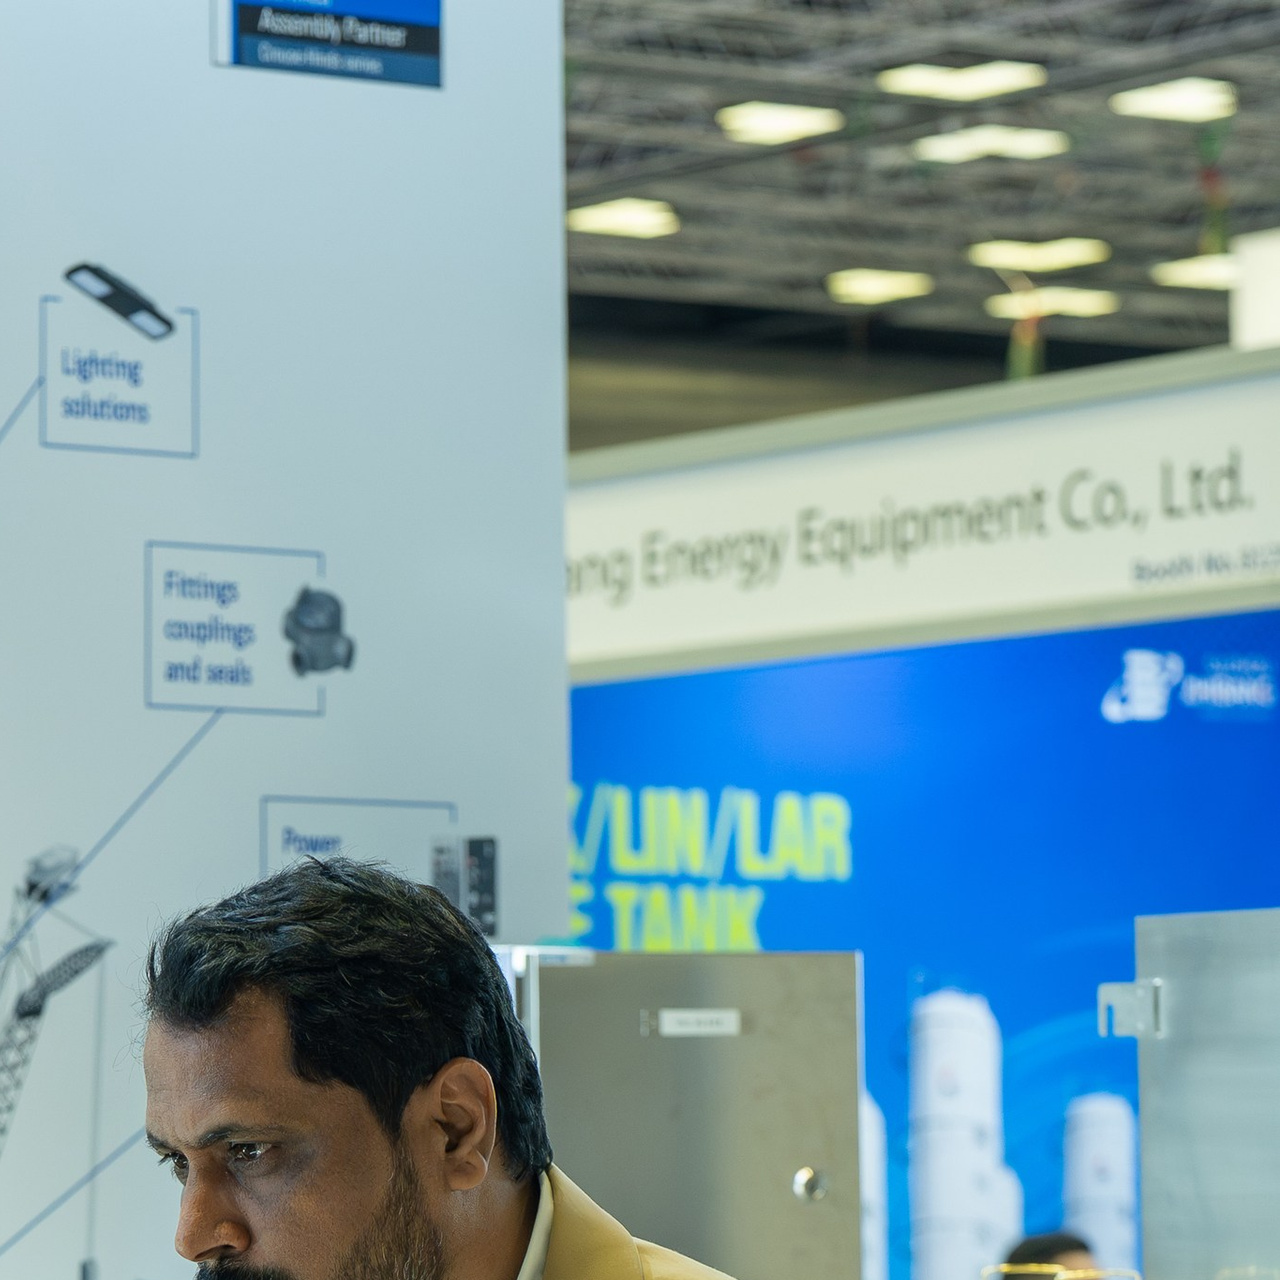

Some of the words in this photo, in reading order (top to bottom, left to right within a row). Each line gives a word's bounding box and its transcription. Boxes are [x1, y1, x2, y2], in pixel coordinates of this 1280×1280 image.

[257, 6, 342, 46] Assembly
[342, 15, 408, 48] Partner
[60, 349, 143, 387] Lighting
[62, 391, 150, 424] solutions
[640, 528, 790, 594] Energy
[797, 484, 1047, 578] Equipment
[1059, 467, 1149, 535] Co.,
[1160, 444, 1256, 521] Ltd.
[164, 569, 240, 608] Fittings
[164, 614, 256, 650] couplings
[164, 654, 202, 684] and
[206, 657, 254, 686] seals
[282, 826, 342, 852] Power
[603, 880, 765, 953] TANK
